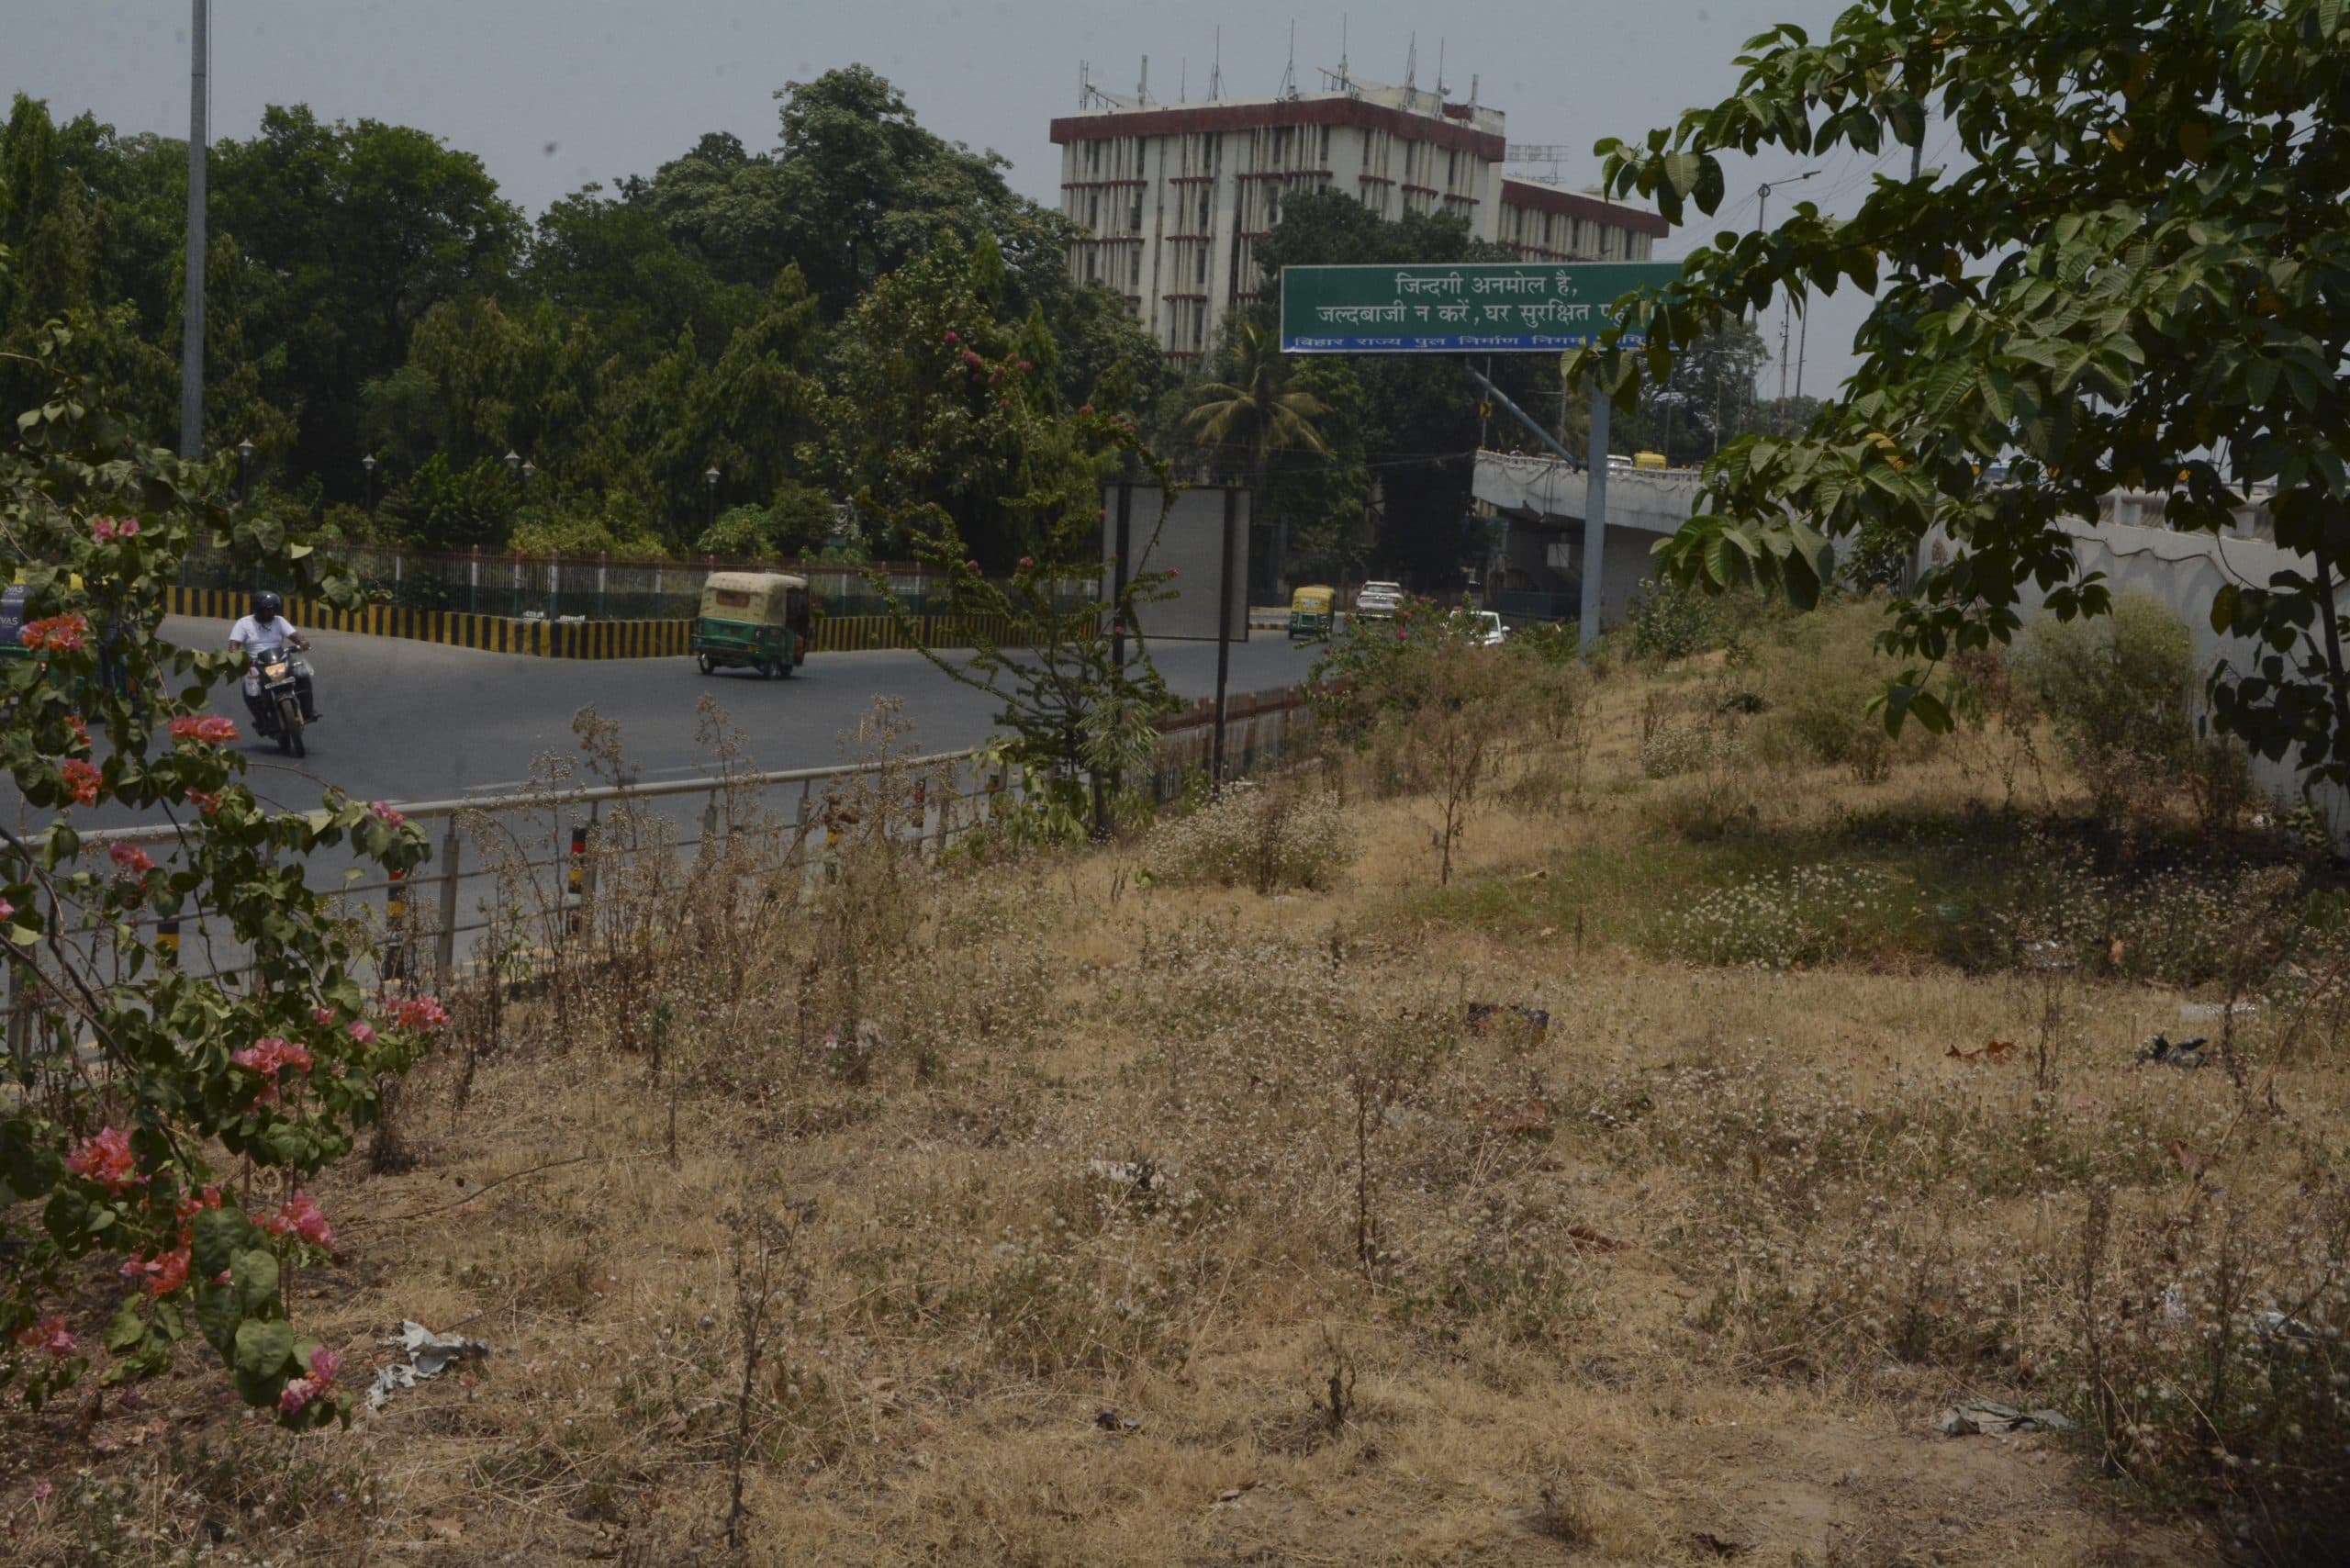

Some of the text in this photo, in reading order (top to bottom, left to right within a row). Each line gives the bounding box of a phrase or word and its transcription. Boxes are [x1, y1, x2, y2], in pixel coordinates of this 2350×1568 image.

[1395, 272, 1464, 297] जिन्दगी
[1472, 271, 1548, 295] अनमोल
[1315, 299, 1407, 325] जल्दबाजी
[1414, 305, 1430, 322] न
[1517, 298, 1591, 328] सुरक्षित
